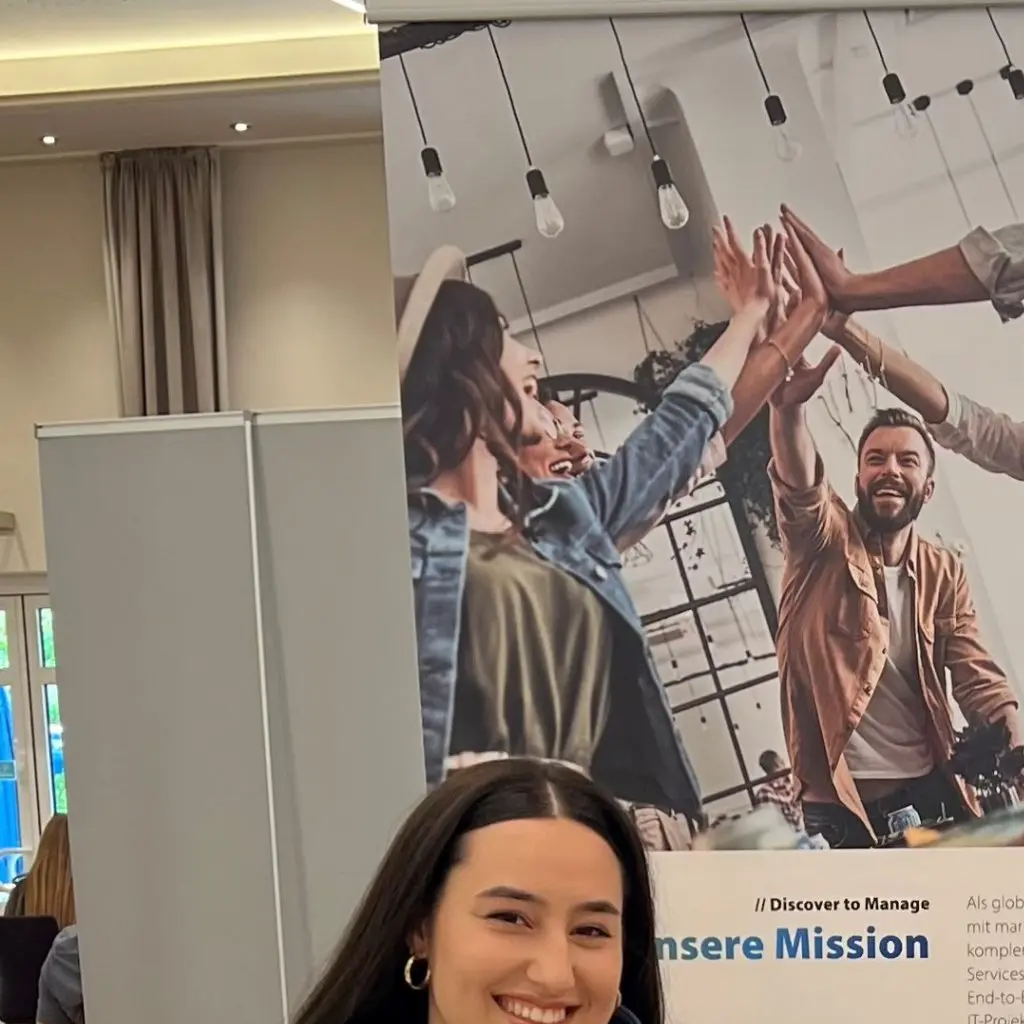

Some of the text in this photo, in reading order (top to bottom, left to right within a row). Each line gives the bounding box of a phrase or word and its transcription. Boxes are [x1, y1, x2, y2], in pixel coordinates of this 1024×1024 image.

[770, 897, 840, 911] Discover
[844, 898, 861, 910] to
[865, 897, 930, 914] Manage
[966, 896, 988, 910] Als
[967, 919, 991, 934] mit
[655, 926, 929, 960] nsere Mission
[967, 966, 1024, 981] Services
